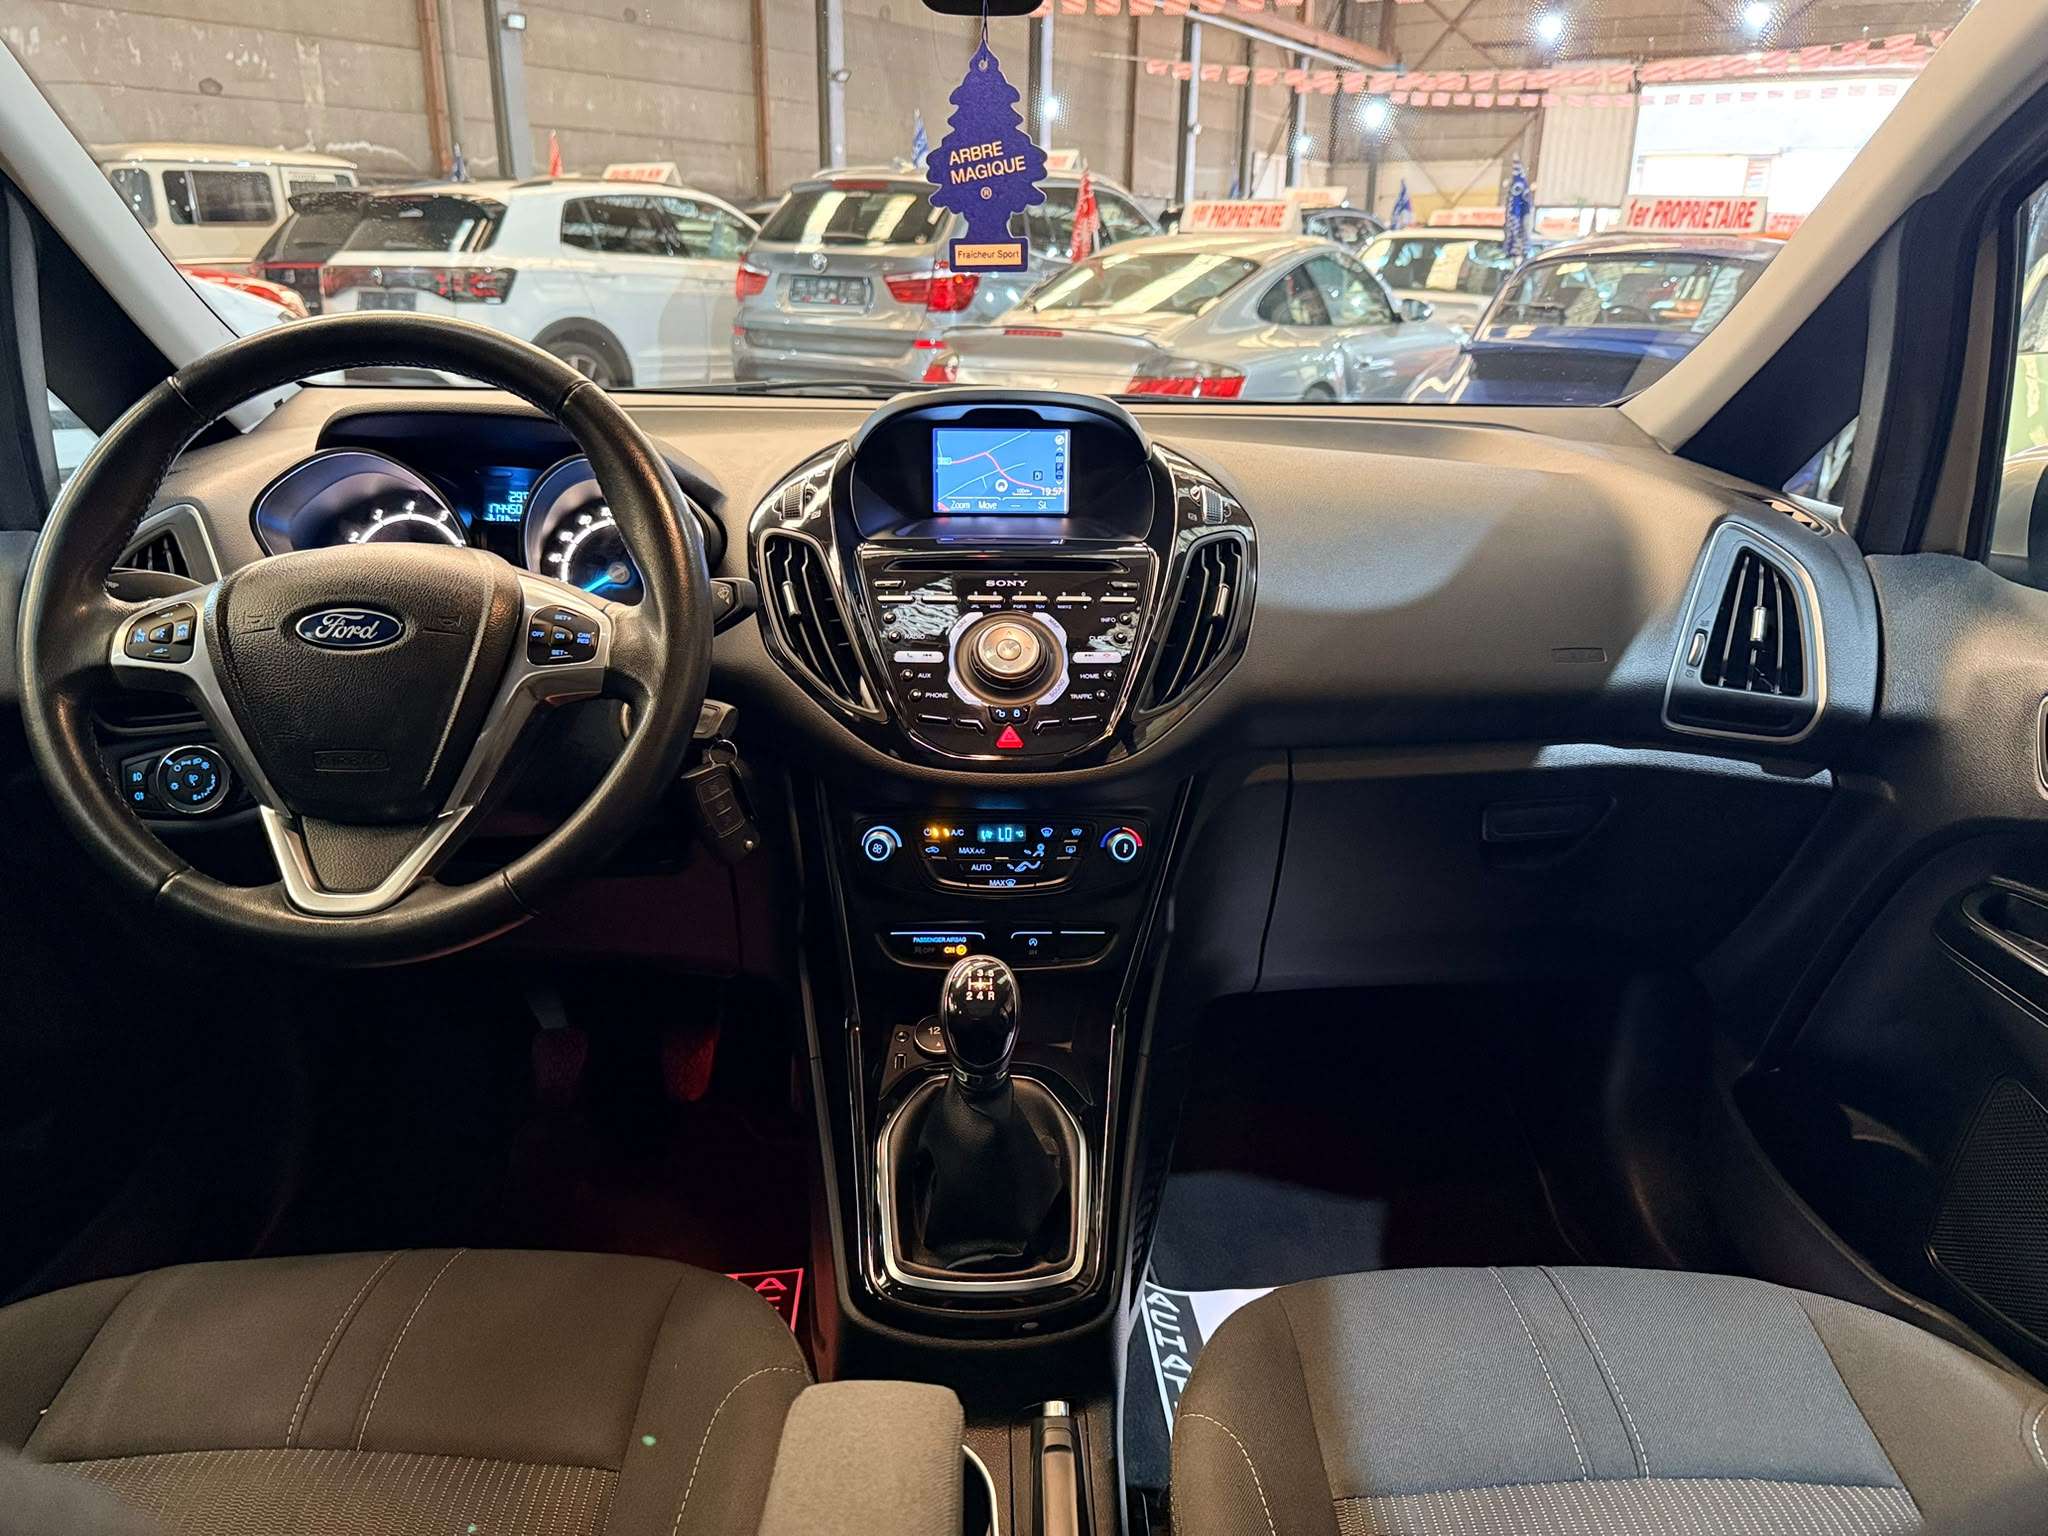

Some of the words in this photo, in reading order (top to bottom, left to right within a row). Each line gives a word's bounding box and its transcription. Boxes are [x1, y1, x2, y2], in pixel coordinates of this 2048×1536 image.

[949, 140, 1004, 166] ARBRE
[950, 155, 1026, 184] MAGIQUE
[1626, 199, 1651, 227] 1er
[1650, 199, 1758, 229] PROPRIETAIRE
[997, 249, 1020, 262] Sport
[951, 500, 971, 510] Zoom
[978, 500, 998, 510] Move
[373, 509, 383, 520] 3
[348, 532, 359, 542] 2
[985, 579, 1029, 588] SONY
[314, 613, 379, 640] Ford
[976, 969, 984, 977] 3
[965, 991, 973, 1001] 2
[976, 991, 984, 1001] 4
[987, 991, 995, 1001] R
[928, 1026, 941, 1035] 12
